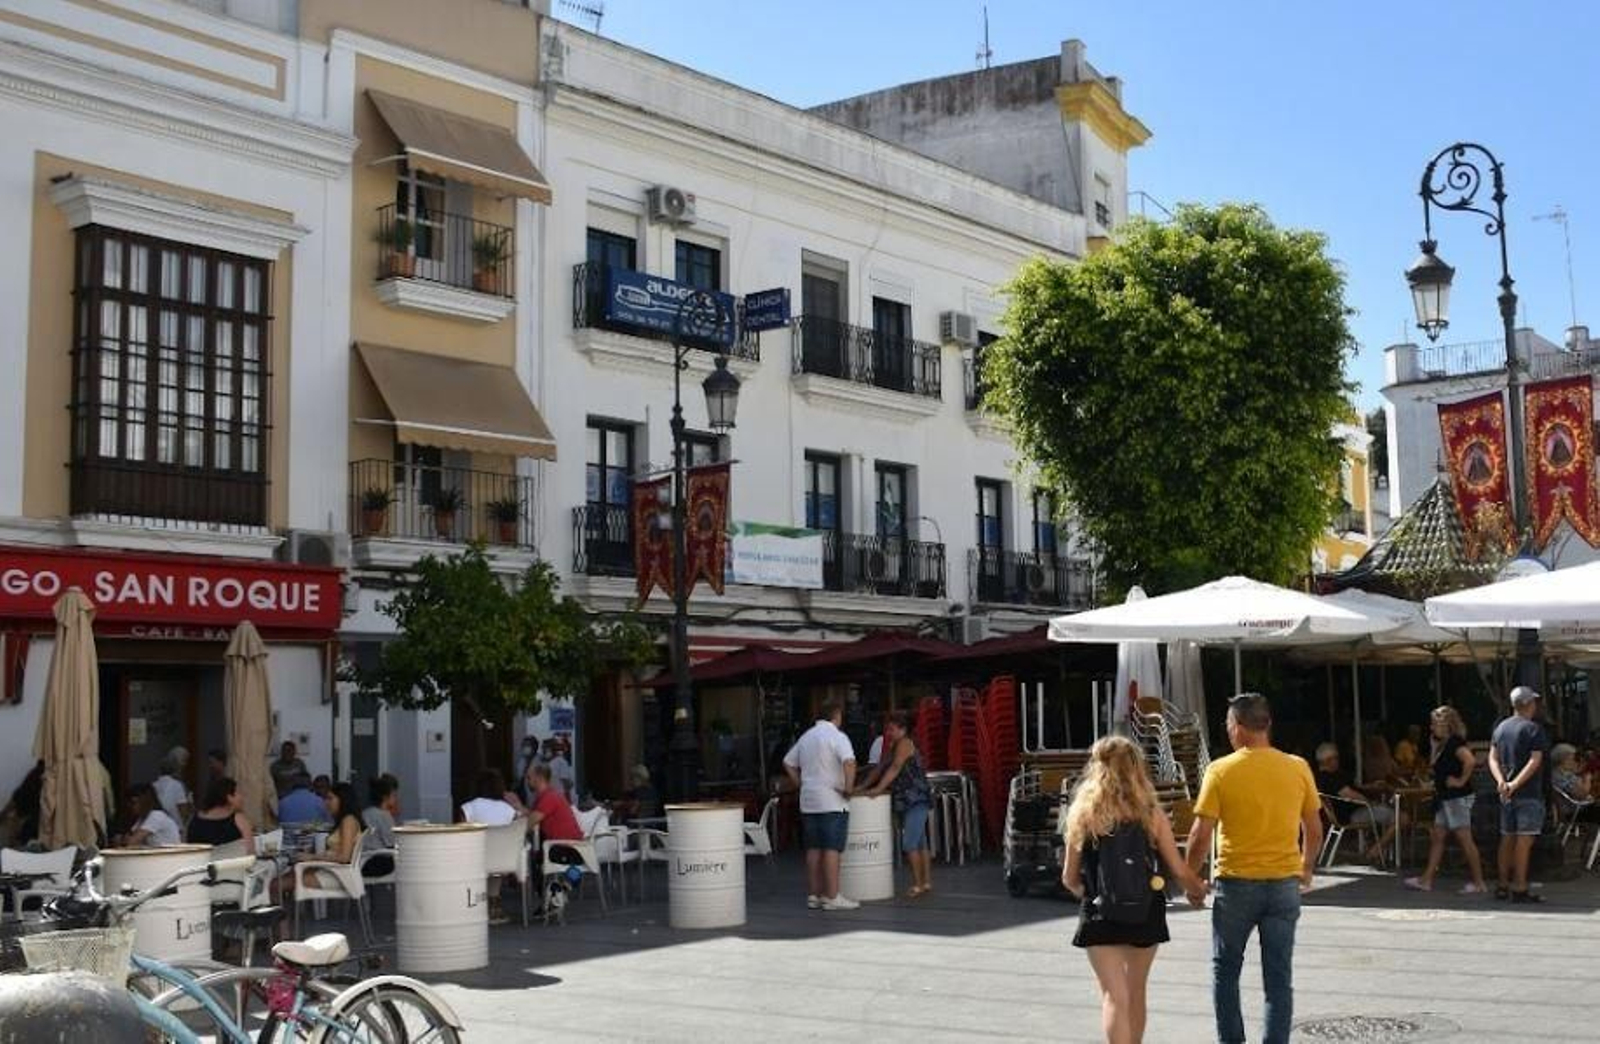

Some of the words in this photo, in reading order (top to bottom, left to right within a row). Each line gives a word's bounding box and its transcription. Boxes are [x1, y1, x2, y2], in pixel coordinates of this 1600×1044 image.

[1, 568, 61, 595] GO
[94, 571, 173, 605] SAN
[188, 576, 320, 613] ROQUE
